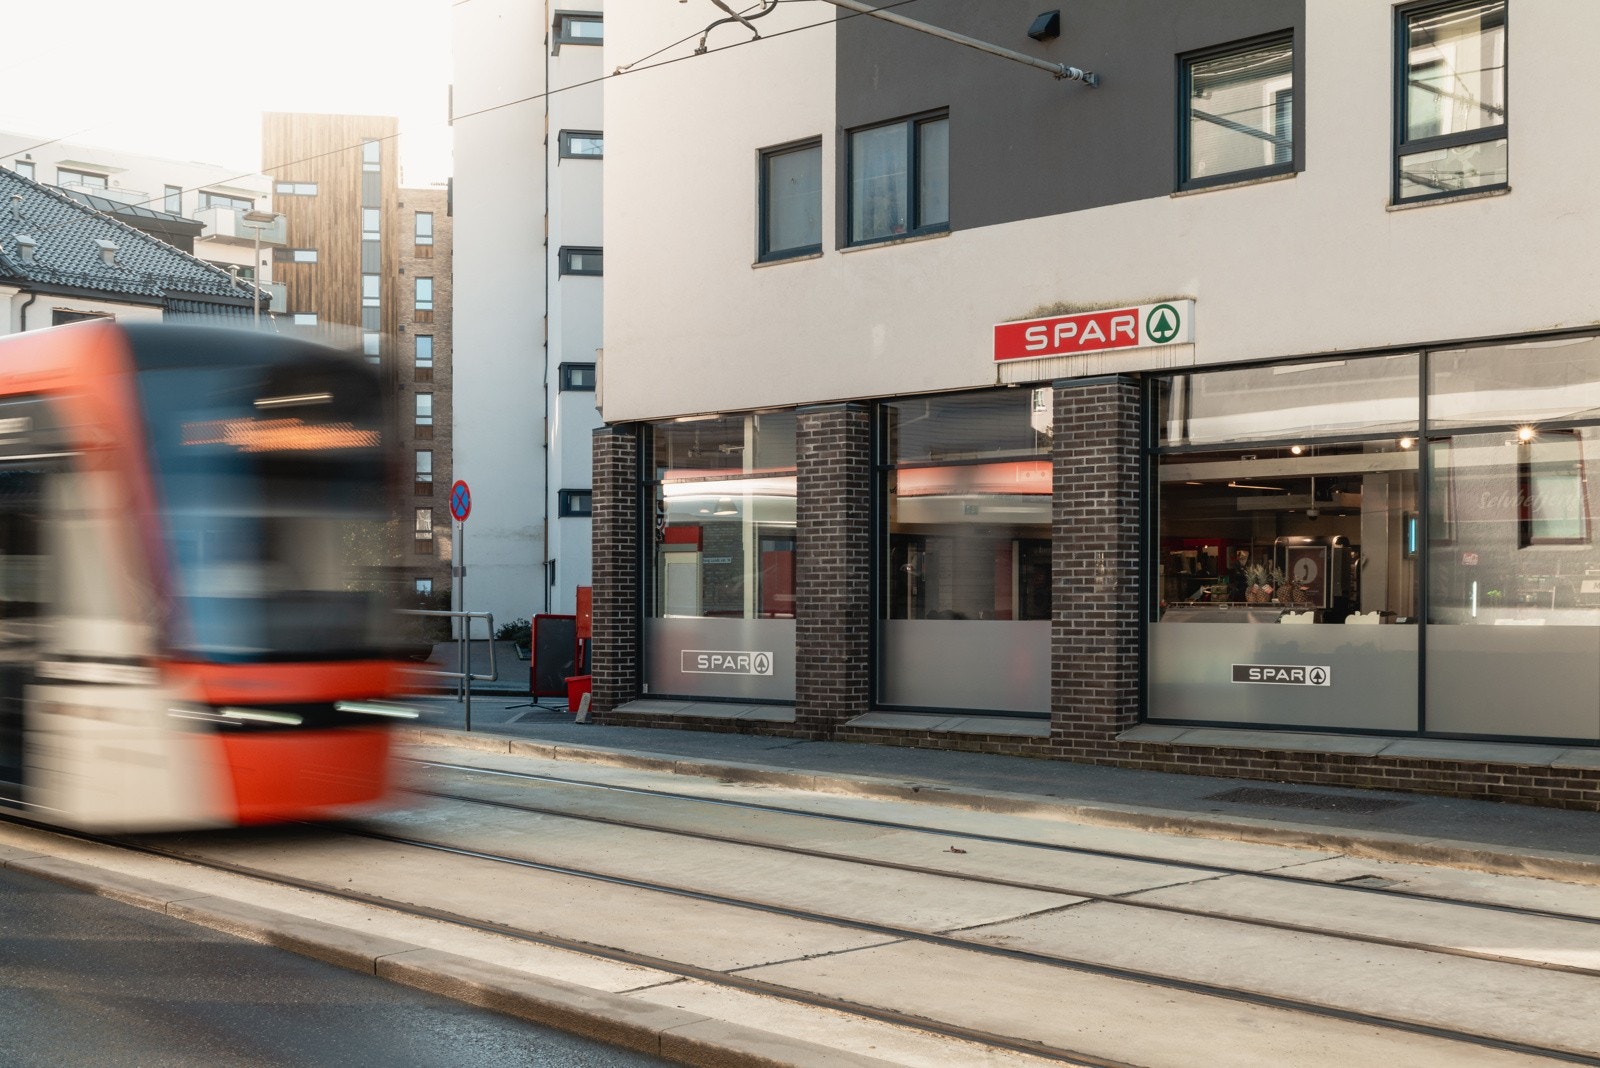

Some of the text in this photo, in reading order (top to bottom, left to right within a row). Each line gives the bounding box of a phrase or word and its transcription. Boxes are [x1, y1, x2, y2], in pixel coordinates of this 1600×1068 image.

[1025, 314, 1136, 351] SPAR
[697, 654, 750, 670] SPAR
[1248, 668, 1304, 681] SPAR
